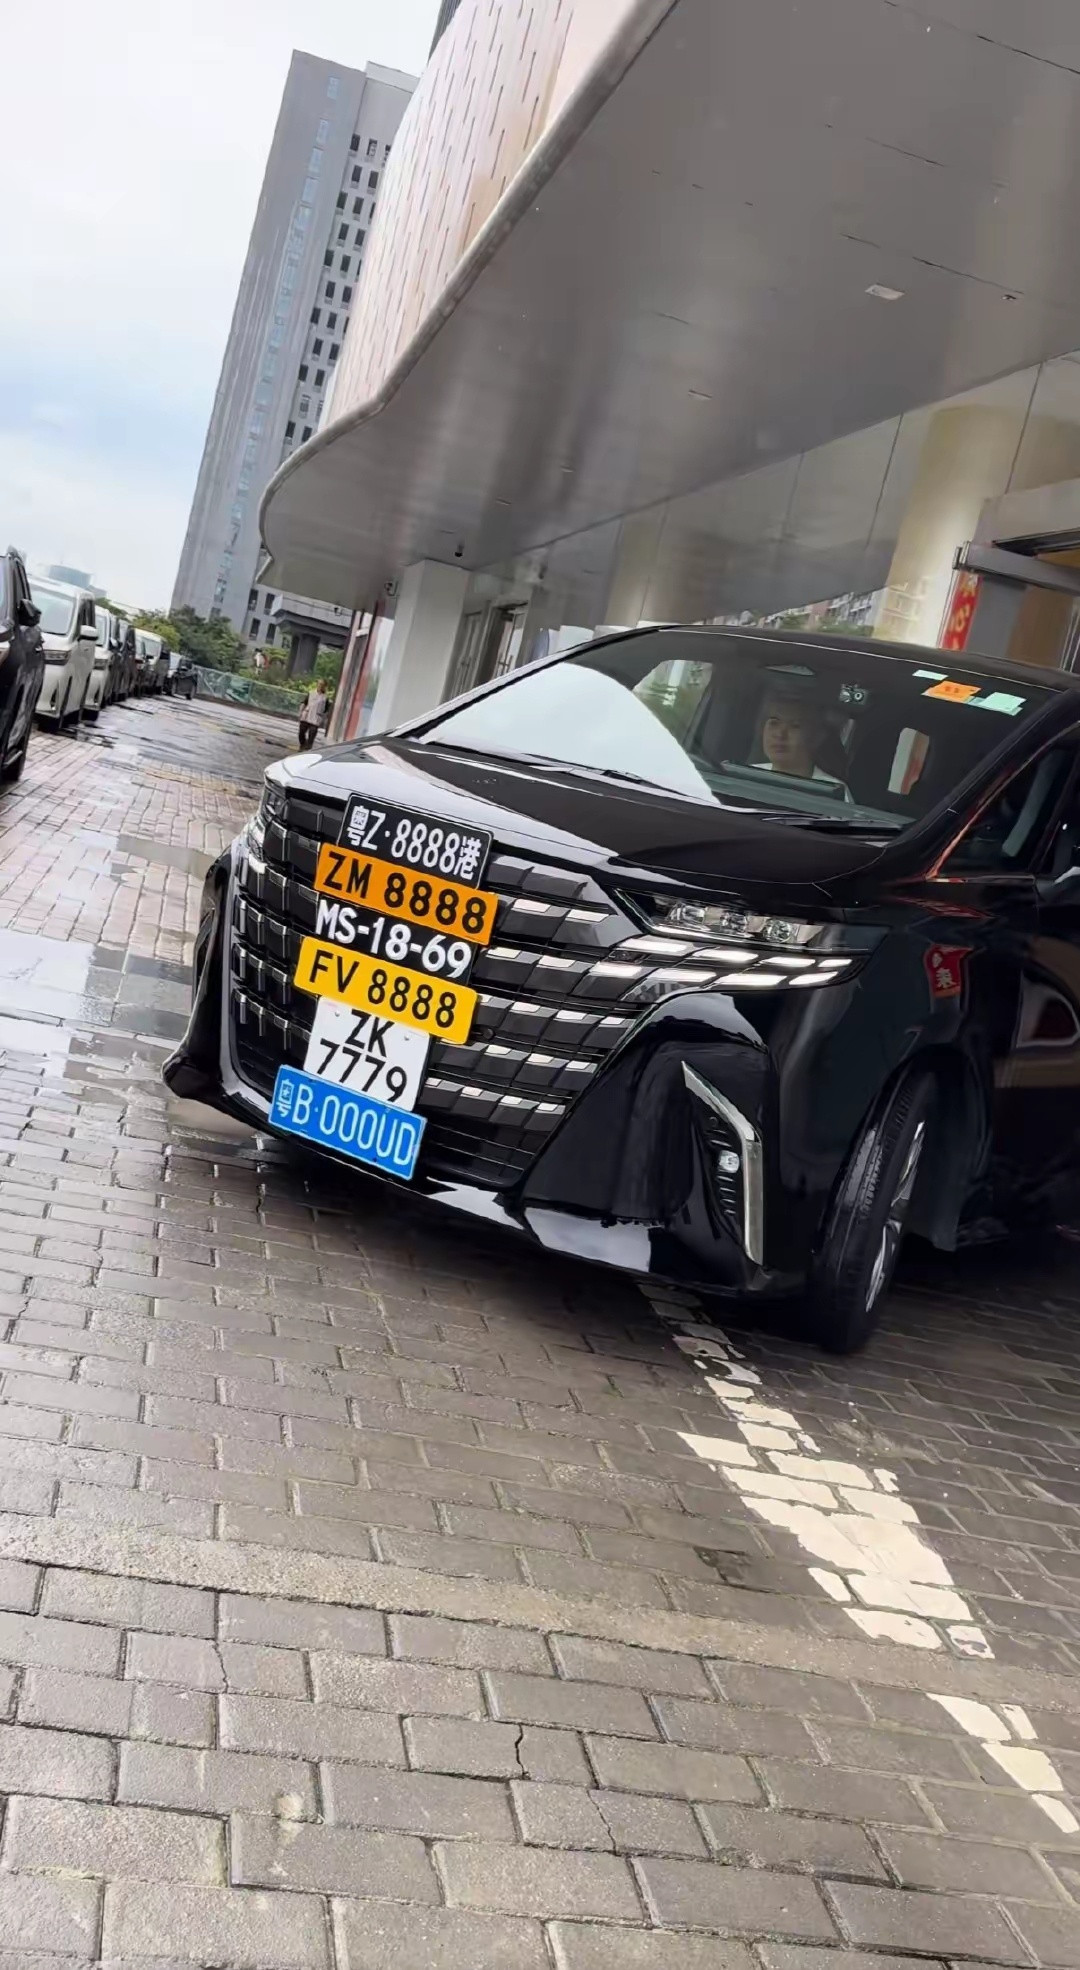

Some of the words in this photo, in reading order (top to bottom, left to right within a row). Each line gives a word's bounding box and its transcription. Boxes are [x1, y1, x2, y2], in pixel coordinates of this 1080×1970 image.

[323, 851, 372, 899] ZM
[384, 872, 487, 934] 8888
[315, 900, 472, 978] MS-18-69
[309, 949, 360, 993] FV
[367, 968, 457, 1028] 8888
[316, 1038, 407, 1102] 7779
[345, 1009, 395, 1058] ZK
